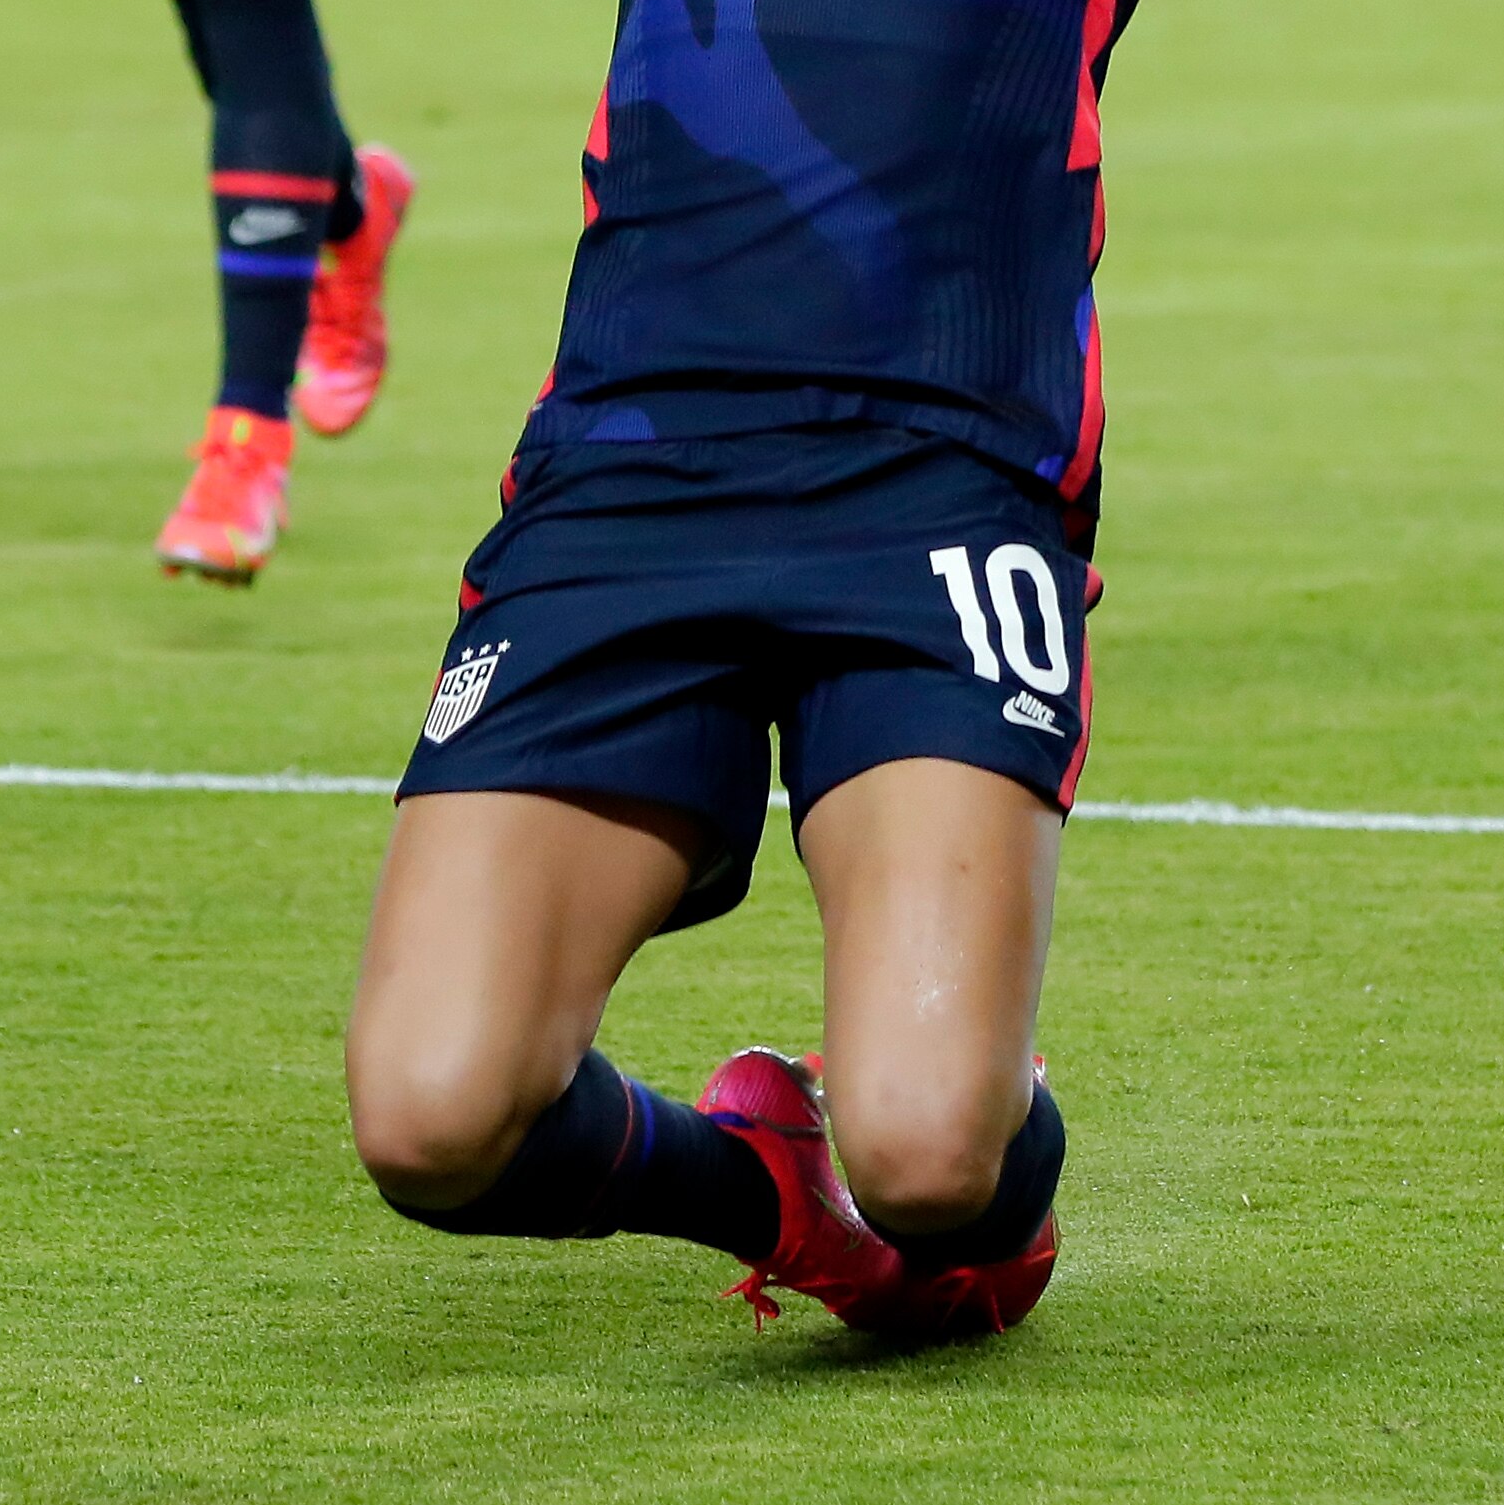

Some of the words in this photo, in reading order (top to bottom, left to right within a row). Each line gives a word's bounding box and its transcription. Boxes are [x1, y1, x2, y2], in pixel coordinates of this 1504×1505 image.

[929, 542, 1070, 696] 10
[441, 662, 493, 697] USA
[1014, 689, 1056, 725] NIKE
